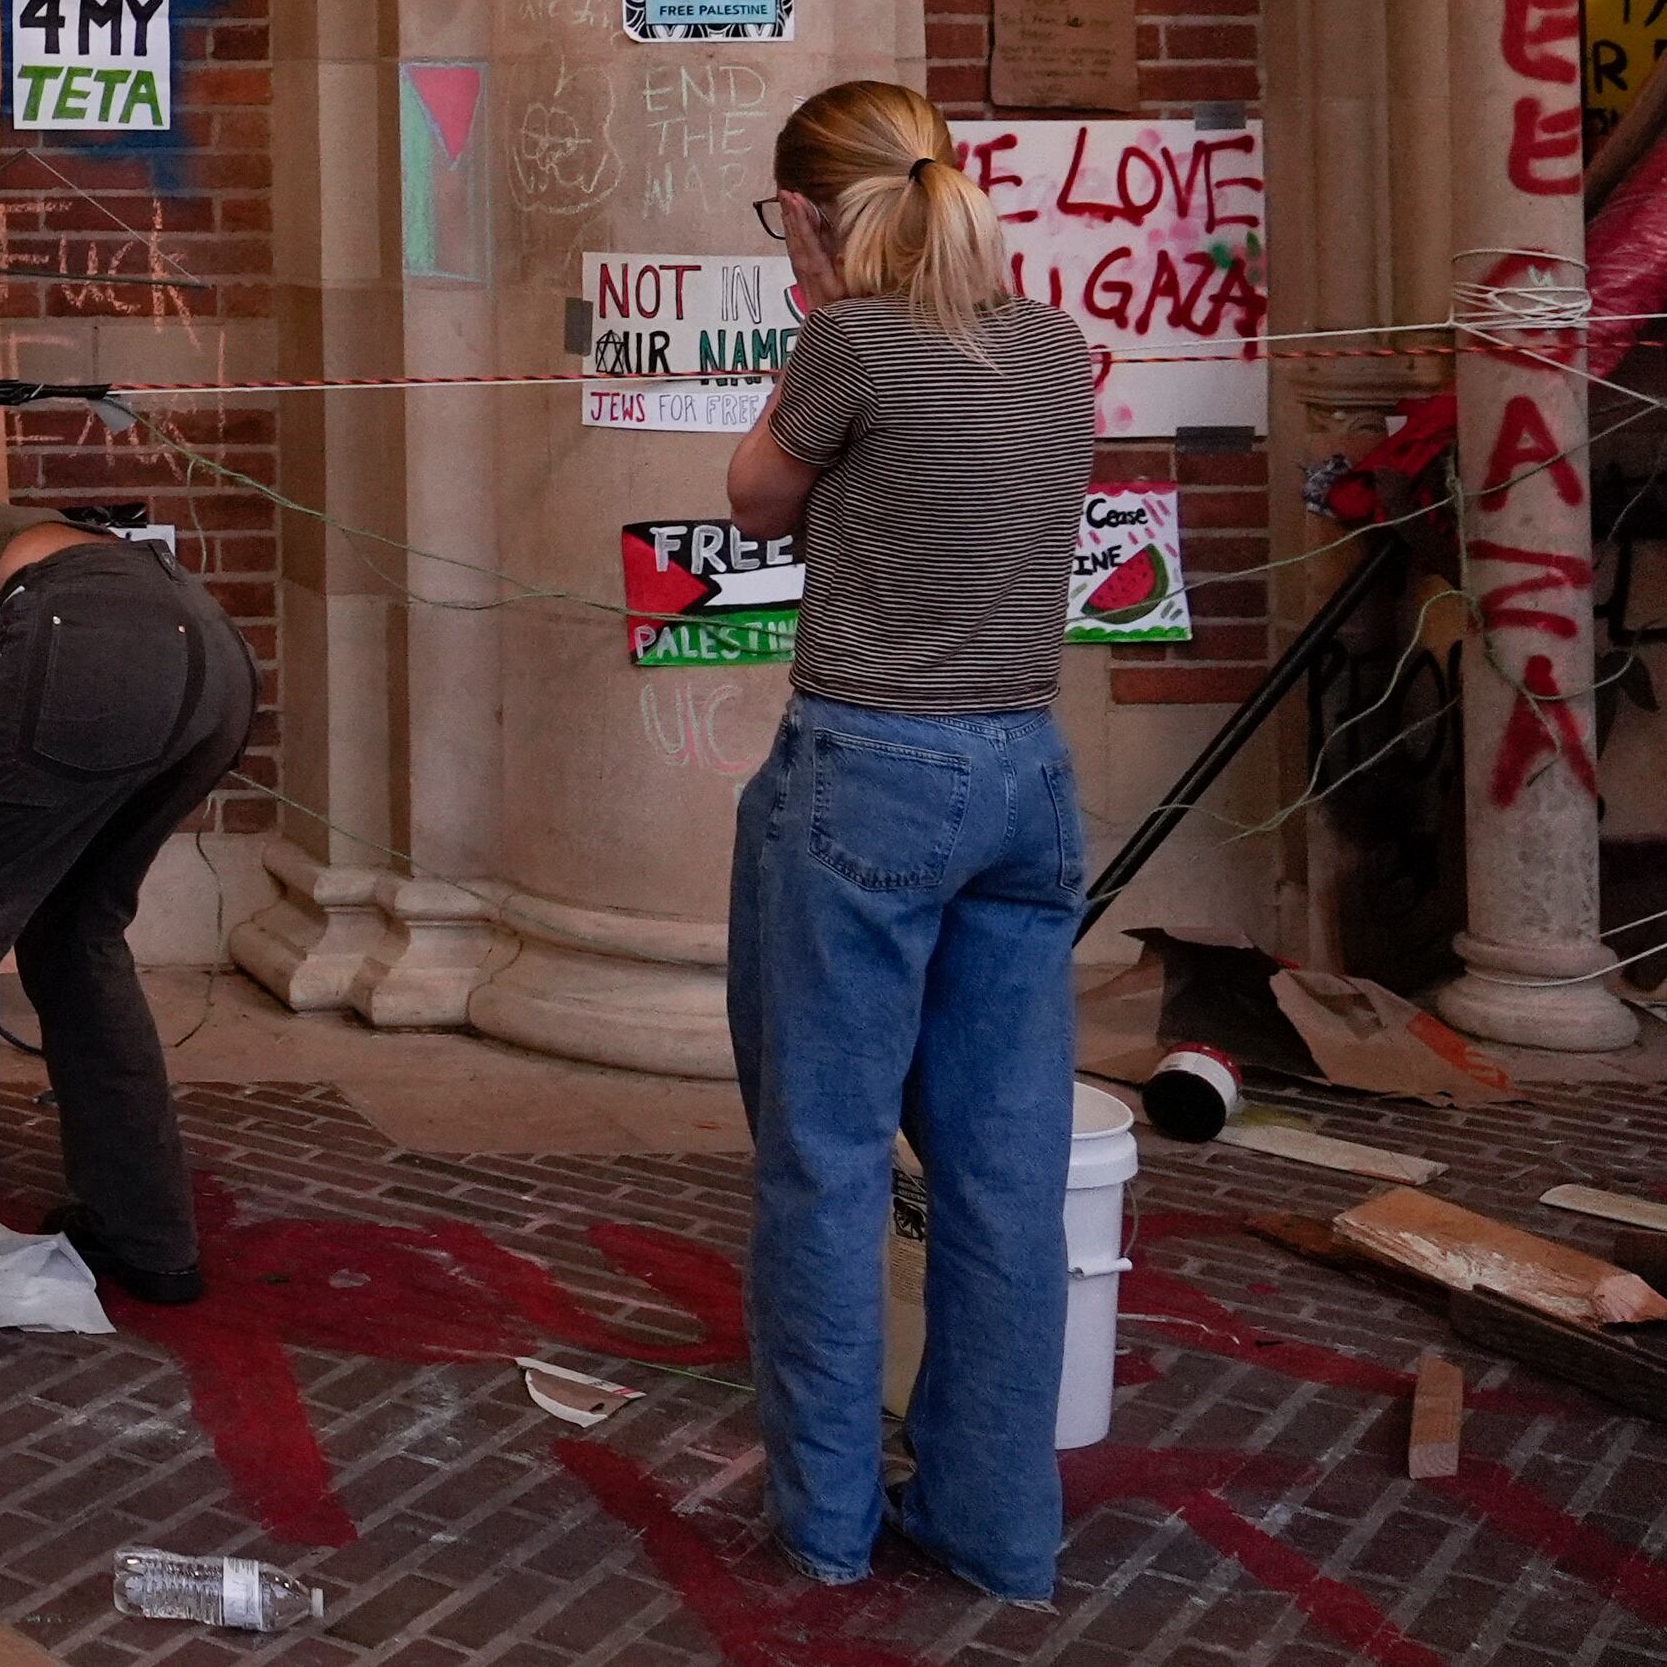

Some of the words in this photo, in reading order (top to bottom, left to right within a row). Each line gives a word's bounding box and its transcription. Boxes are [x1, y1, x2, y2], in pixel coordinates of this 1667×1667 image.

[659, 5, 696, 17] FREE
[699, 4, 768, 17] PALESTINE
[17, 64, 164, 127] TETA
[640, 65, 768, 113] END
[646, 108, 754, 157] THE
[1056, 126, 1263, 234] LOVE
[599, 264, 701, 320] NOT
[721, 265, 761, 324] IN
[1081, 246, 1268, 361] GAZA
[590, 391, 645, 423] JEWS
[658, 394, 698, 424] FOR
[707, 394, 759, 425] FREE
[1086, 497, 1148, 529] Cease
[649, 523, 794, 575] FREE
